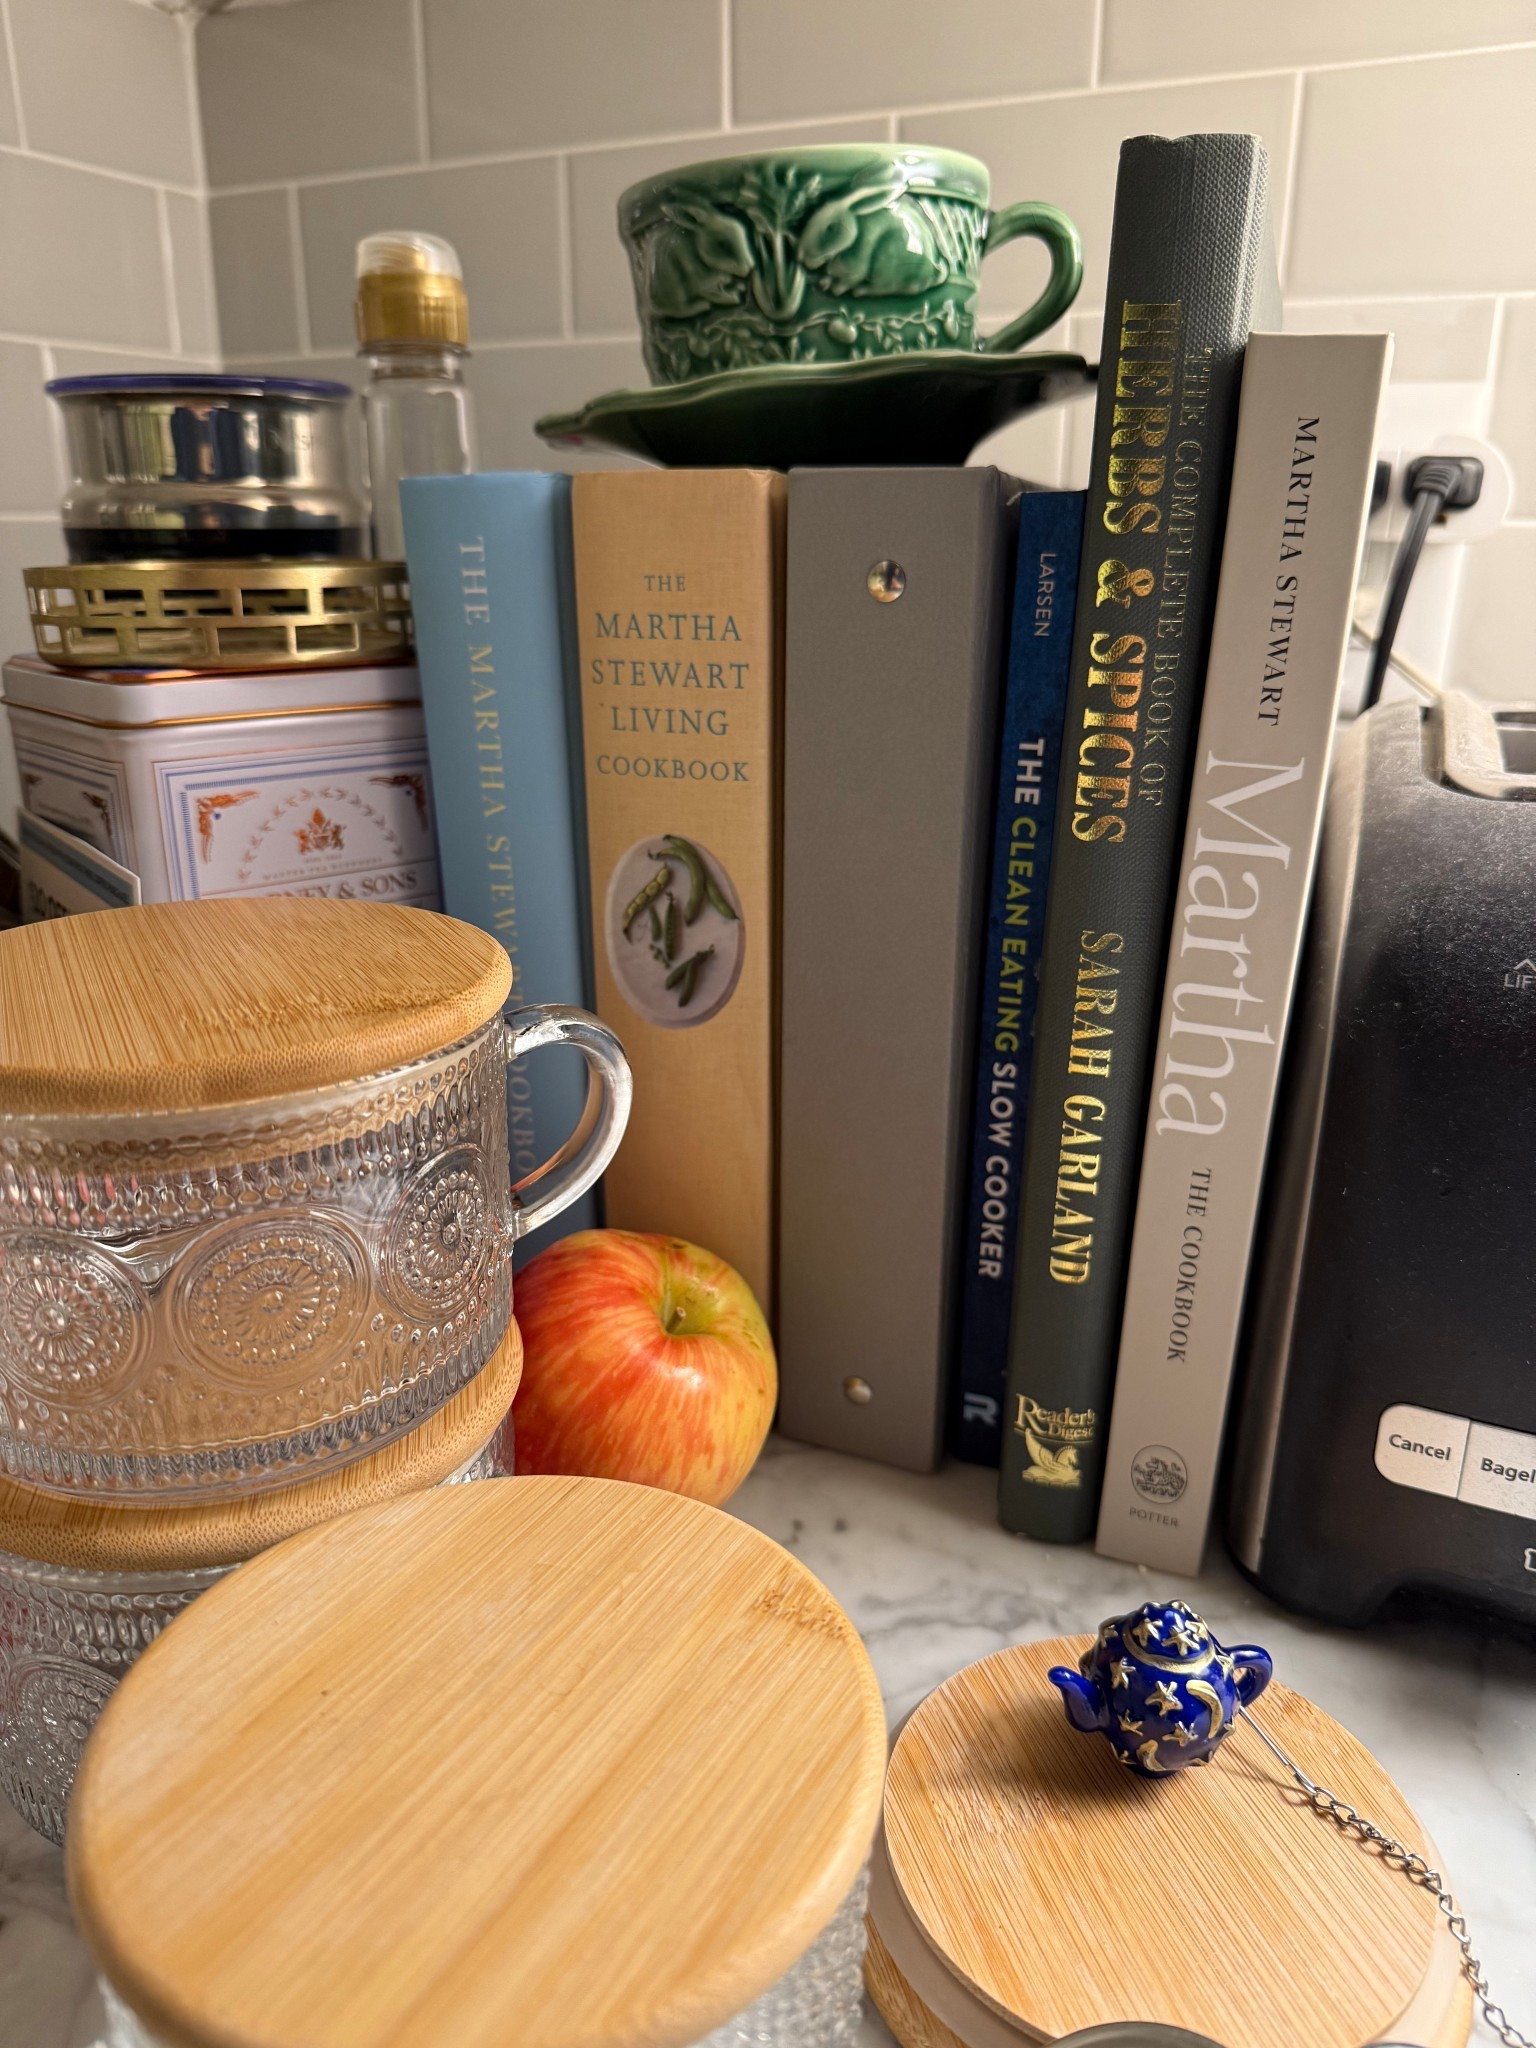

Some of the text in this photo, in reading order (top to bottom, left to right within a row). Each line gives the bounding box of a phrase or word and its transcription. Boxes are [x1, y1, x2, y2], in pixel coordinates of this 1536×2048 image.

[459, 534, 491, 626] THE
[644, 575, 687, 592] THE
[1072, 300, 1182, 842] HERBS & SPICES
[1138, 347, 1213, 806] THE COMPLETE BOOK OF
[1258, 417, 1320, 726] MARTHA STEWART
[1034, 553, 1056, 636] LARSEN
[595, 612, 742, 642] MARTHA
[591, 659, 749, 690] STEWART
[468, 645, 507, 818] MARTHA
[611, 706, 729, 736] LIVING
[596, 755, 750, 782] COOKBOOK
[362, 870, 417, 897] SONS
[1155, 751, 1305, 1136] Martha
[1504, 973, 1536, 989] LIF
[978, 739, 1045, 1280] THE CLEAN EATING SLOW COOKER
[1050, 931, 1124, 1284] SARAH GARLAND
[1167, 1168, 1212, 1363] THE COOKBOOK
[1048, 1422, 1094, 1440] Digest
[1388, 1433, 1451, 1460] Cancel
[1480, 1458, 1536, 1483] Bagel
[1129, 1507, 1180, 1528] POTTER
